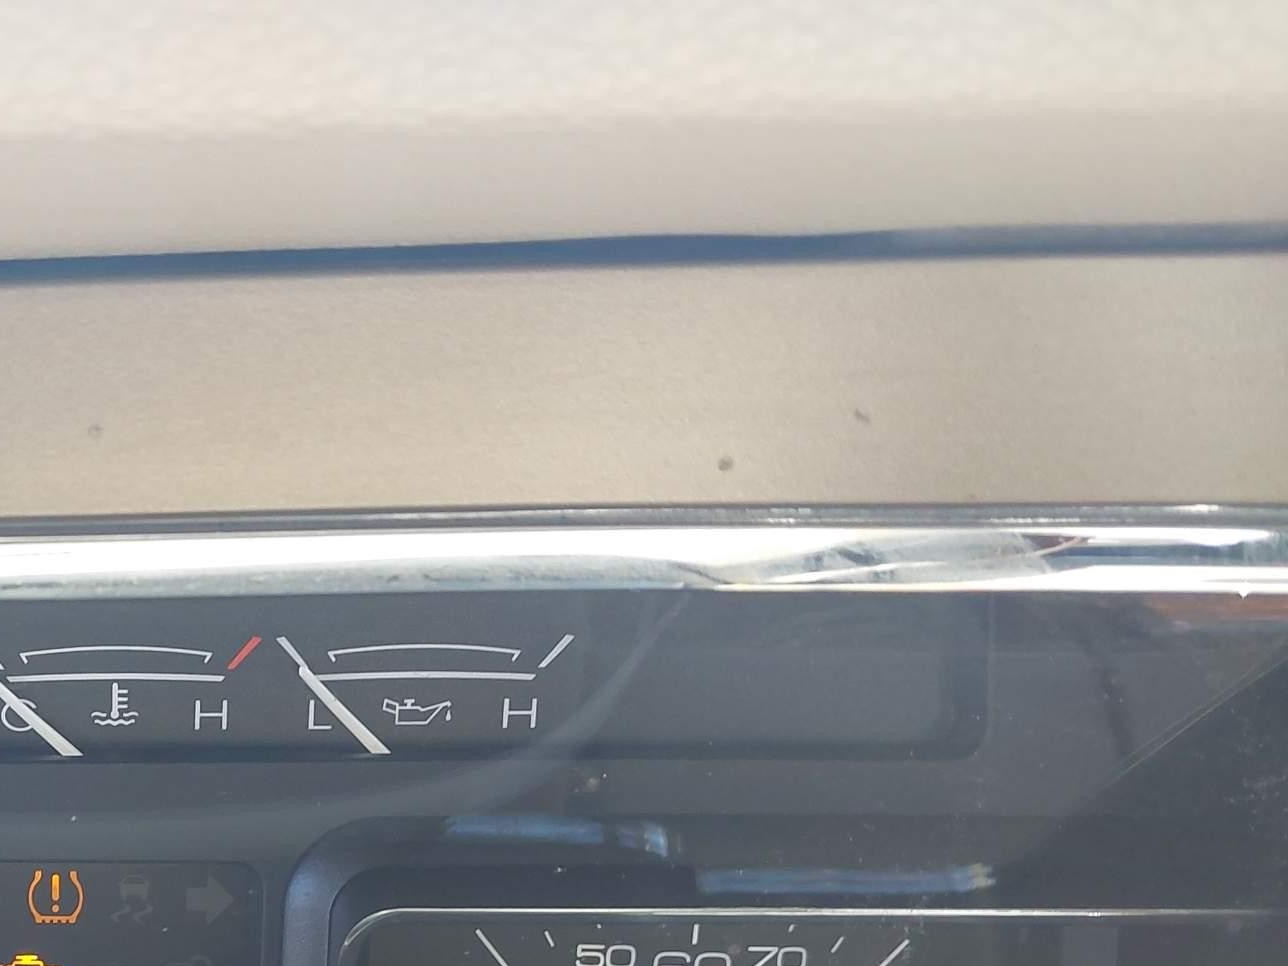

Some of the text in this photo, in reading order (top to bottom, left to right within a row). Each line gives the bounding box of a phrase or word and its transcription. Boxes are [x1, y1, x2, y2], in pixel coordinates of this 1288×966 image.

[194, 699, 228, 730] H
[305, 698, 335, 731] L
[502, 697, 538, 729] H
